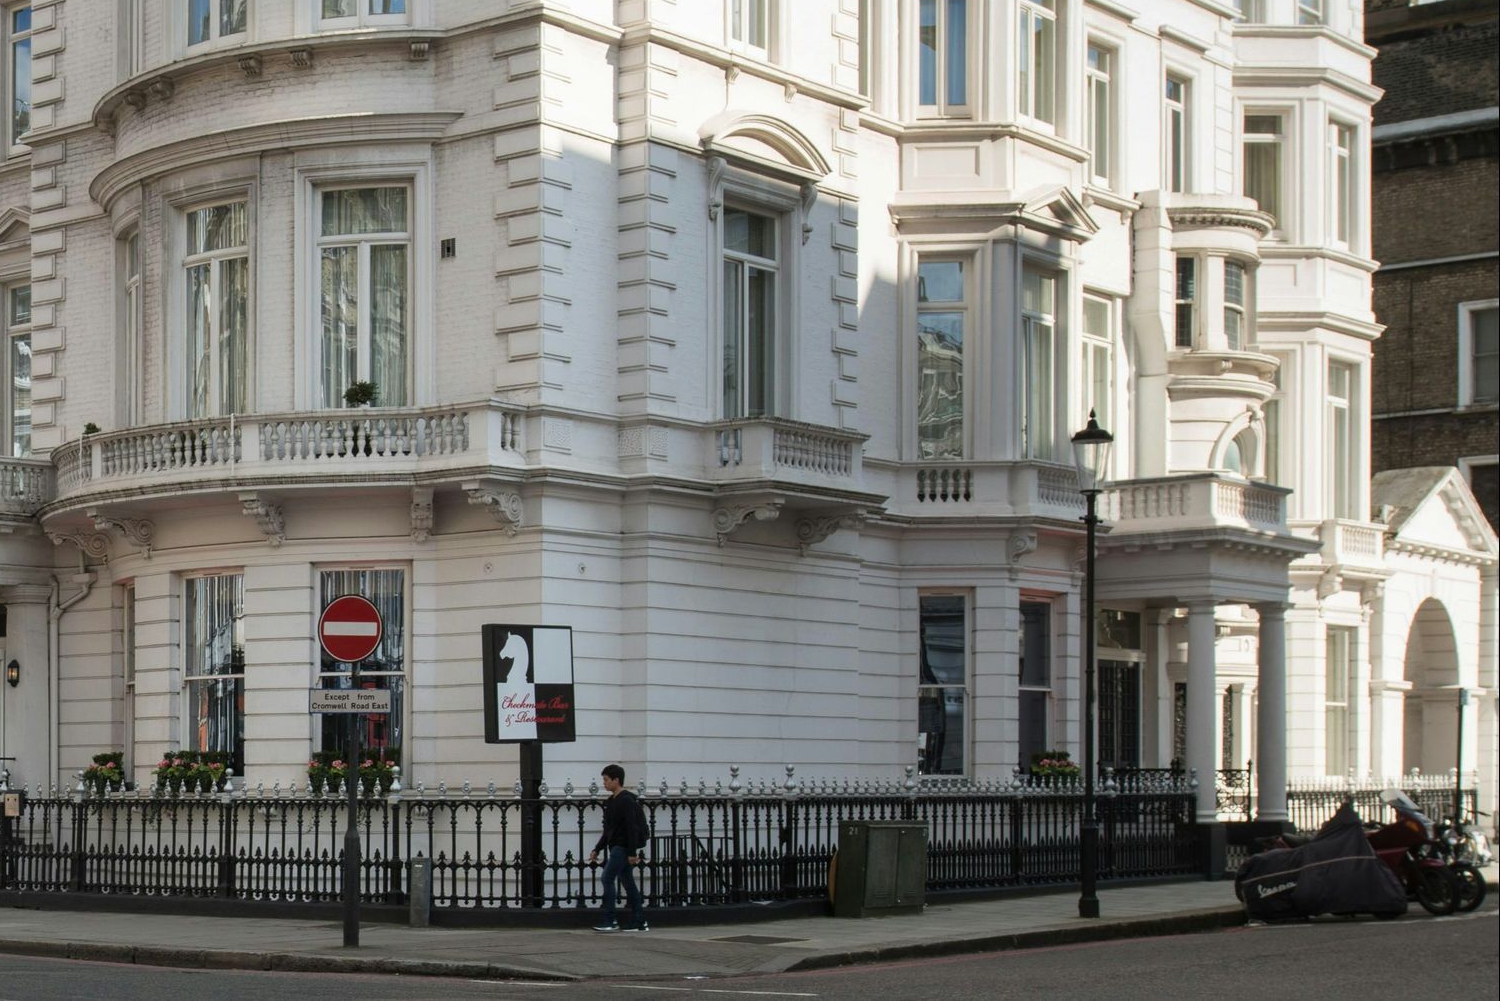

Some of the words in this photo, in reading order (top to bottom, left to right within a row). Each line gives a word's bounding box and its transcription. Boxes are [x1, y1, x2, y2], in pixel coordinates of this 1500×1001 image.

[324, 693, 350, 702] Except
[357, 693, 375, 701] from
[501, 693, 547, 710] Checkmate
[548, 695, 570, 710] Bar
[311, 702, 347, 710] Cromwell
[351, 702, 370, 710] Road
[371, 702, 389, 710] East
[504, 713, 515, 727] &
[1257, 881, 1298, 899] Vespa
